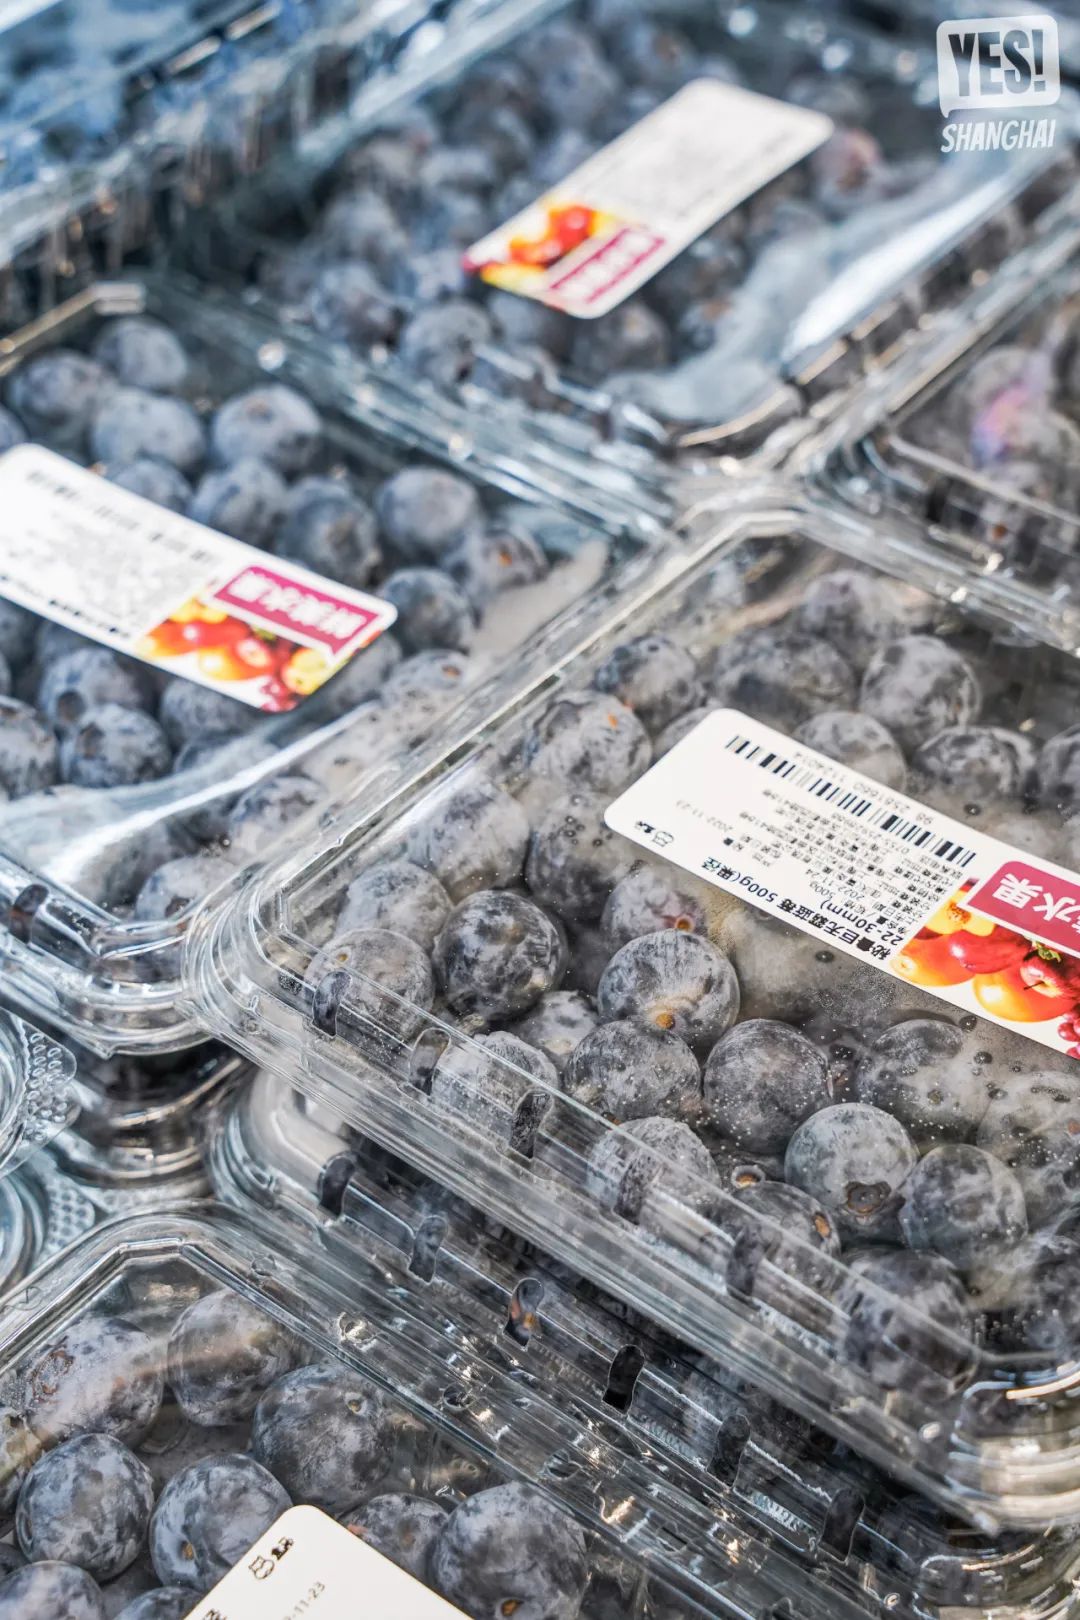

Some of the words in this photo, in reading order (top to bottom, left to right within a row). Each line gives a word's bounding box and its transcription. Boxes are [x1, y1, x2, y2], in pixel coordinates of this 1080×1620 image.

[775, 896, 892, 961] 秘鲁巨无霸蓝莓
[817, 898, 904, 947] 22-30mm)
